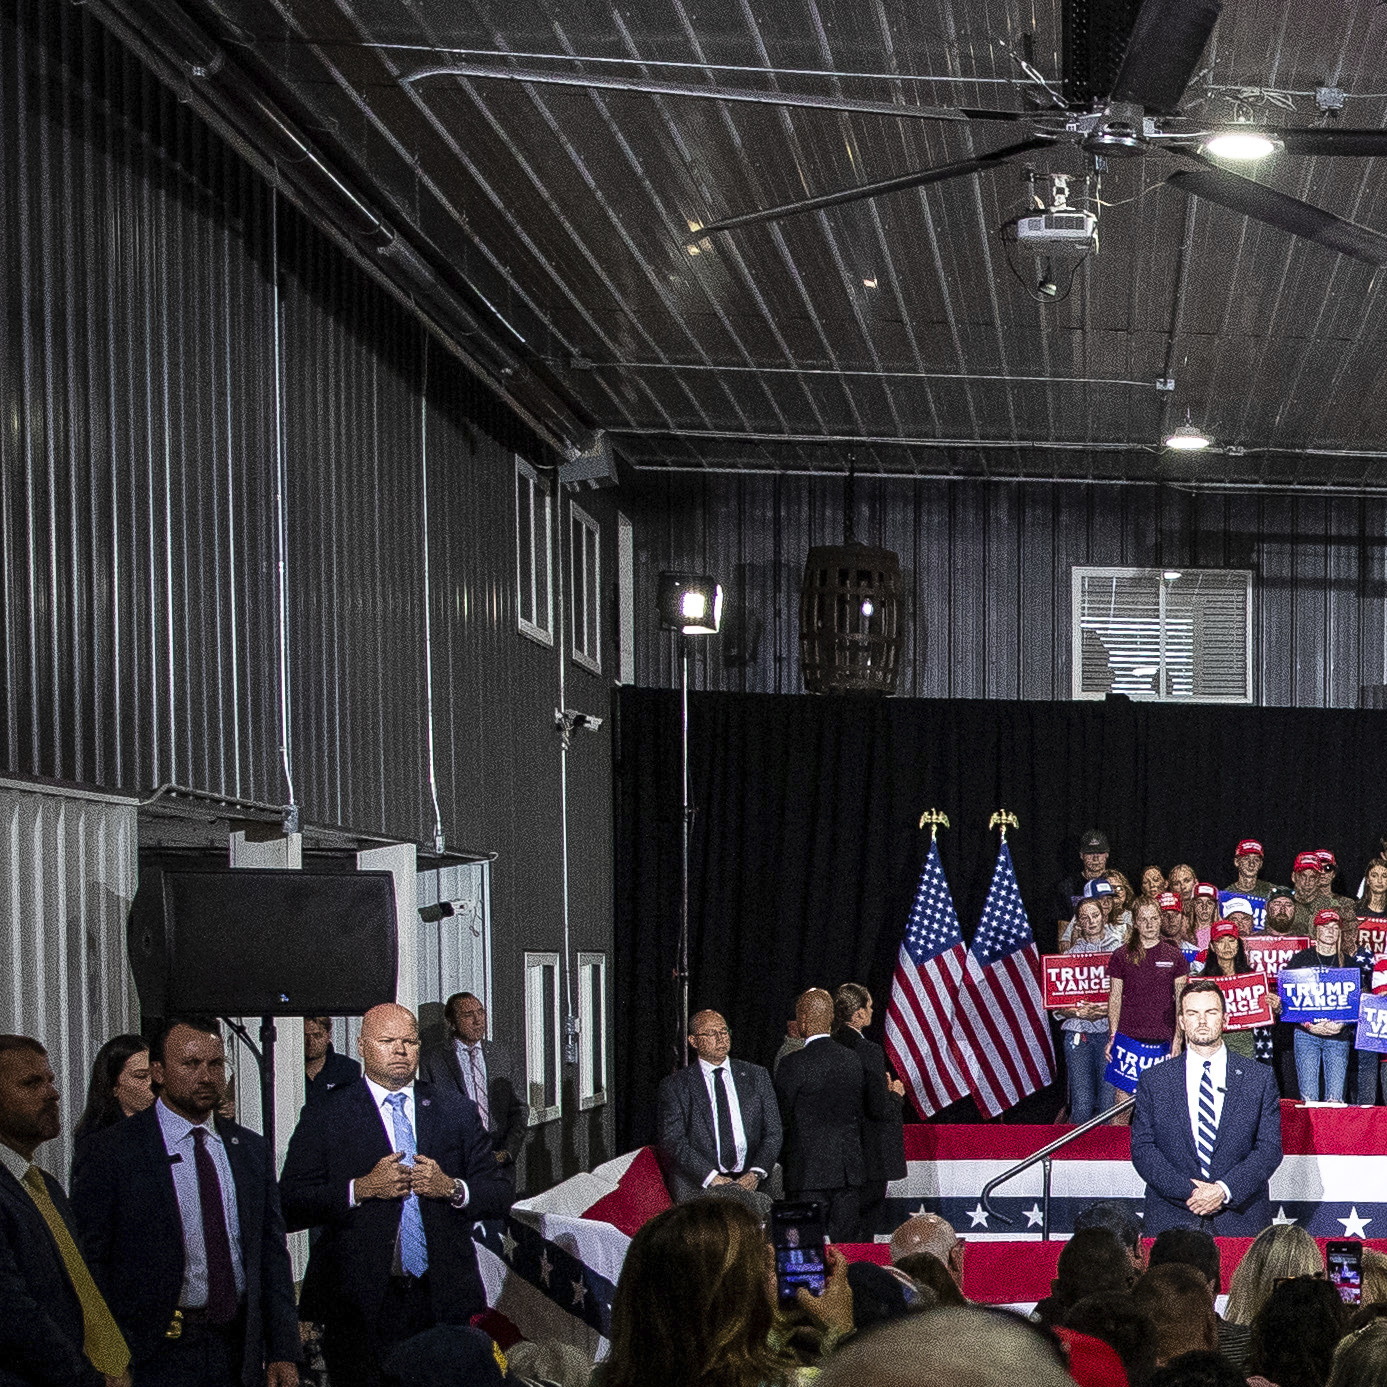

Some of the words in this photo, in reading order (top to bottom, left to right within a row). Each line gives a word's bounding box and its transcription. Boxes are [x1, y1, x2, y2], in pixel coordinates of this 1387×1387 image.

[1048, 965, 1109, 981] TRUM
[1282, 982, 1356, 997] TRUMP
[1291, 994, 1348, 1007] VANCE
